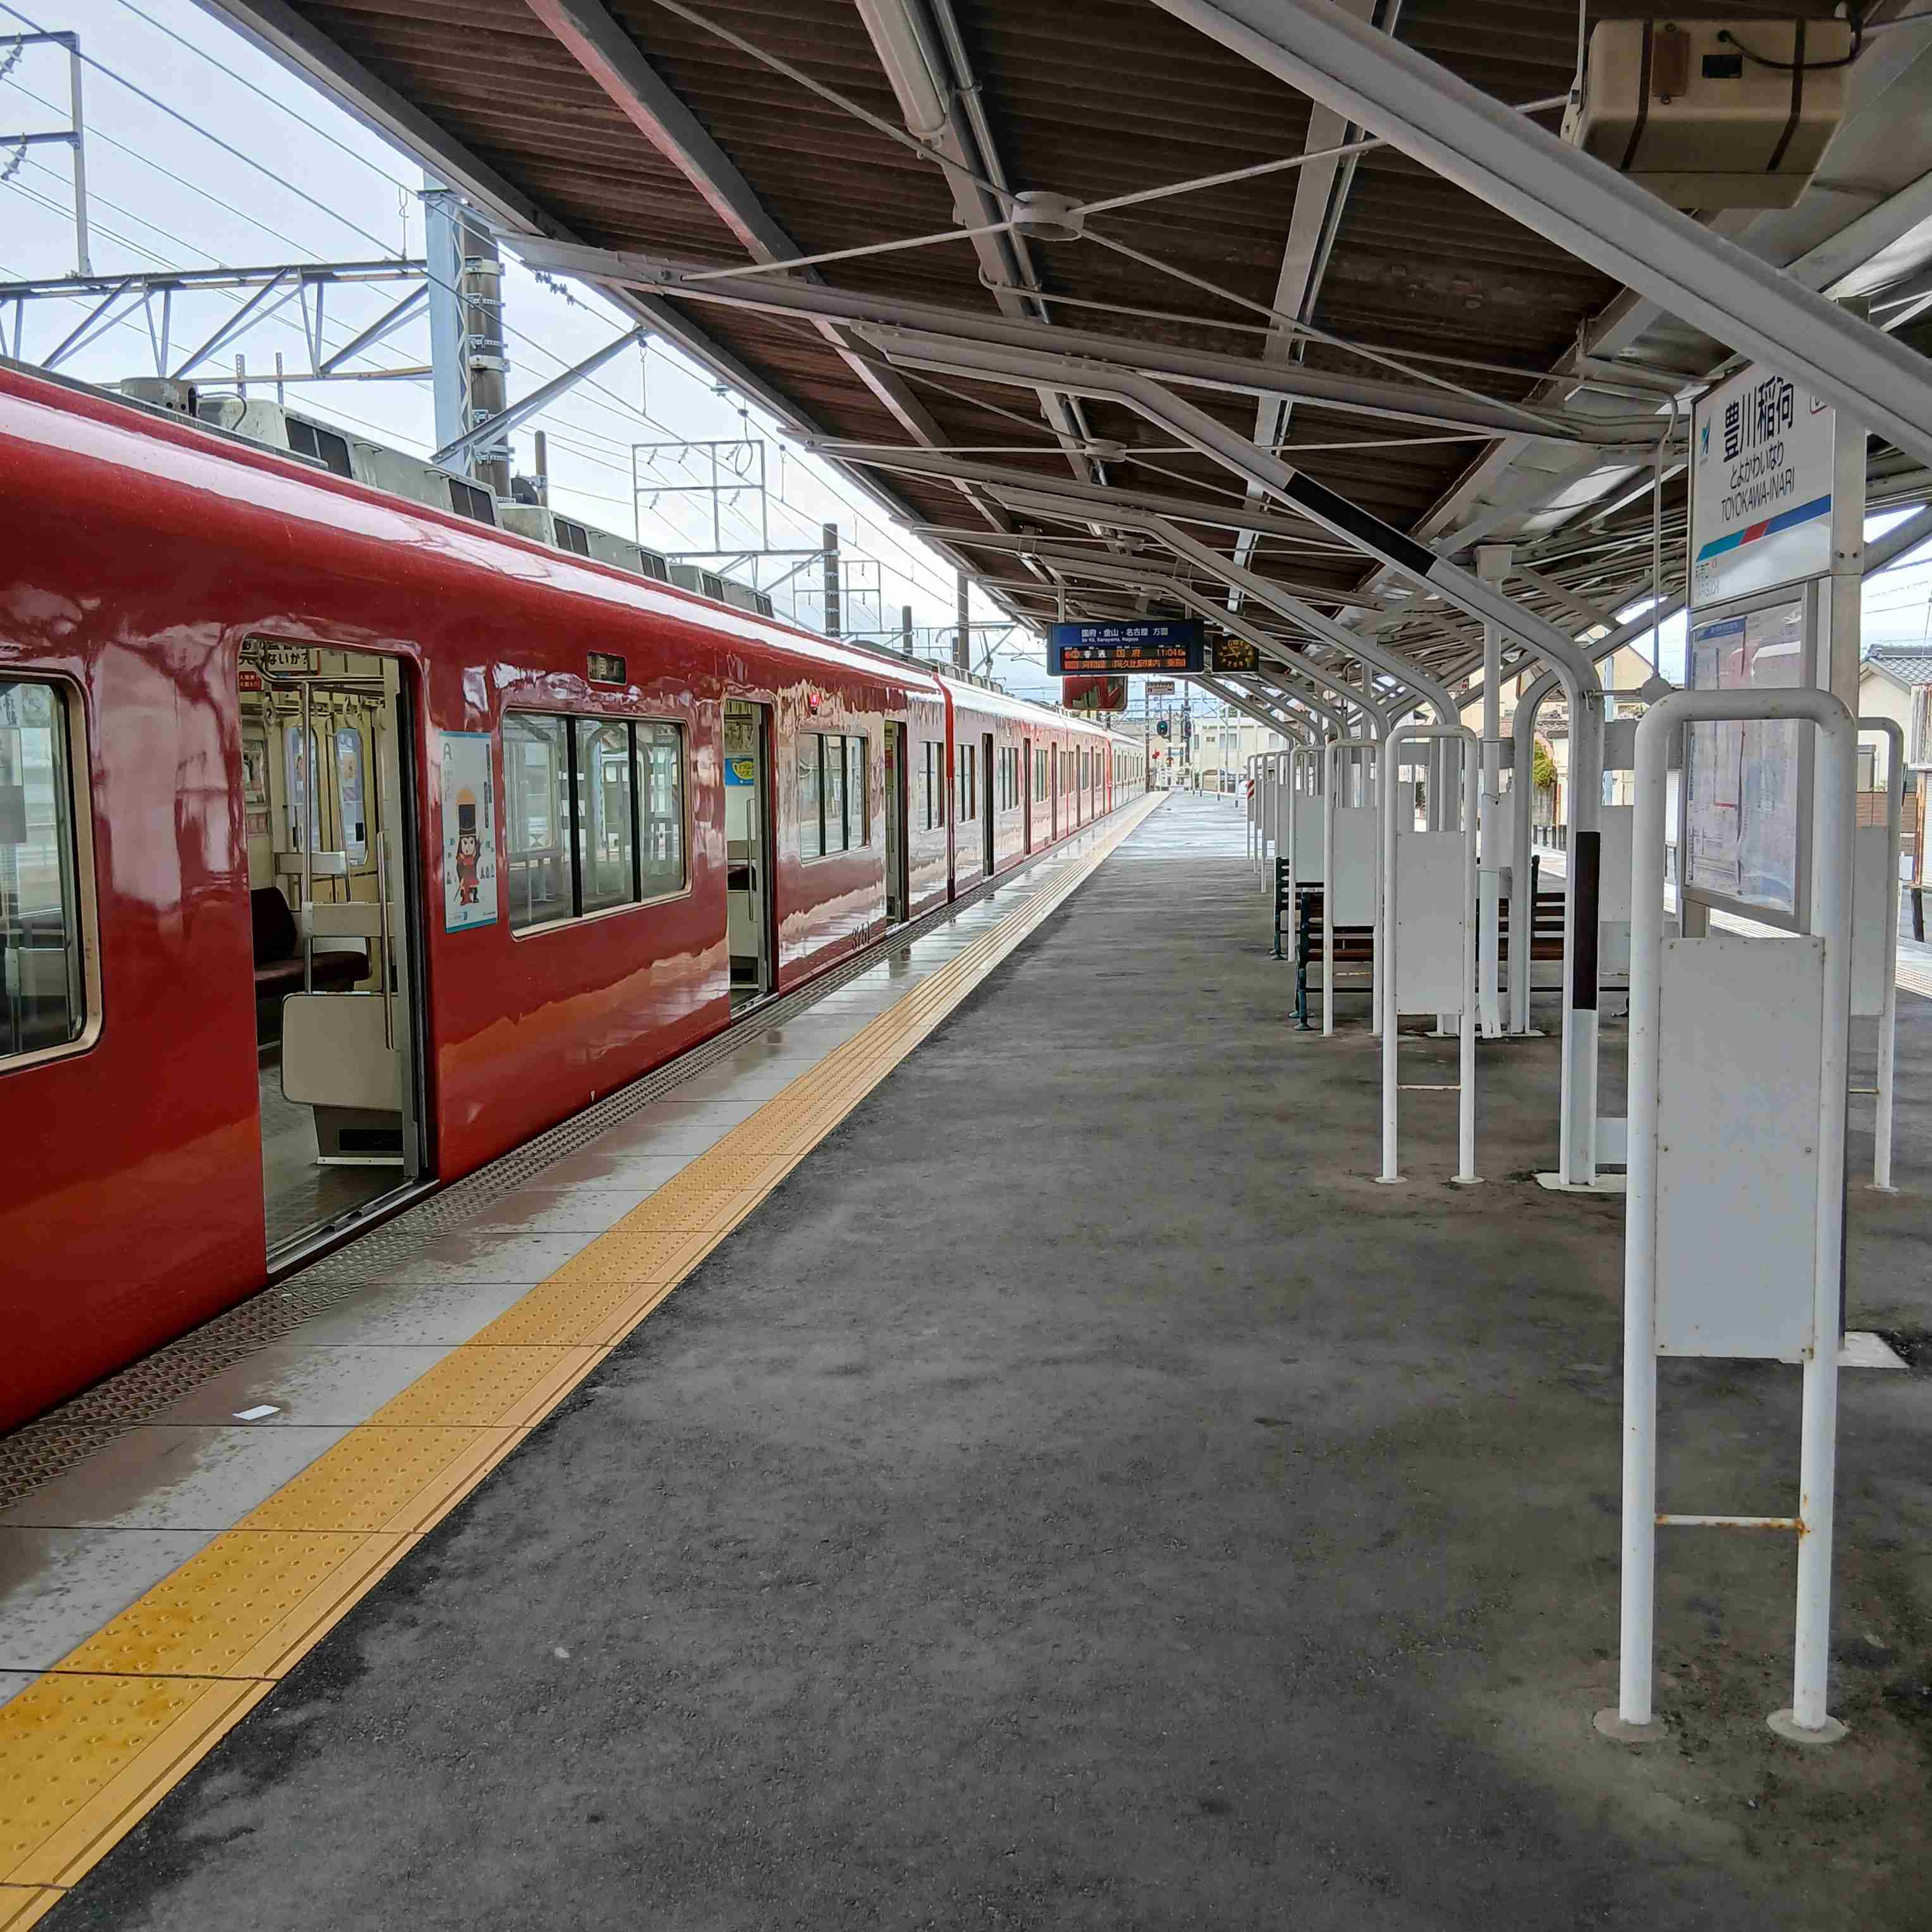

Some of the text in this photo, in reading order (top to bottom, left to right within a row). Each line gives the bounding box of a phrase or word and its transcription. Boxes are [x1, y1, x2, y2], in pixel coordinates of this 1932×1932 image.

[1723, 375, 1794, 463] 豊川稲荷
[1730, 441, 1784, 490] とよかわいなり
[1721, 467, 1795, 523] TOYOKAWA-INARI
